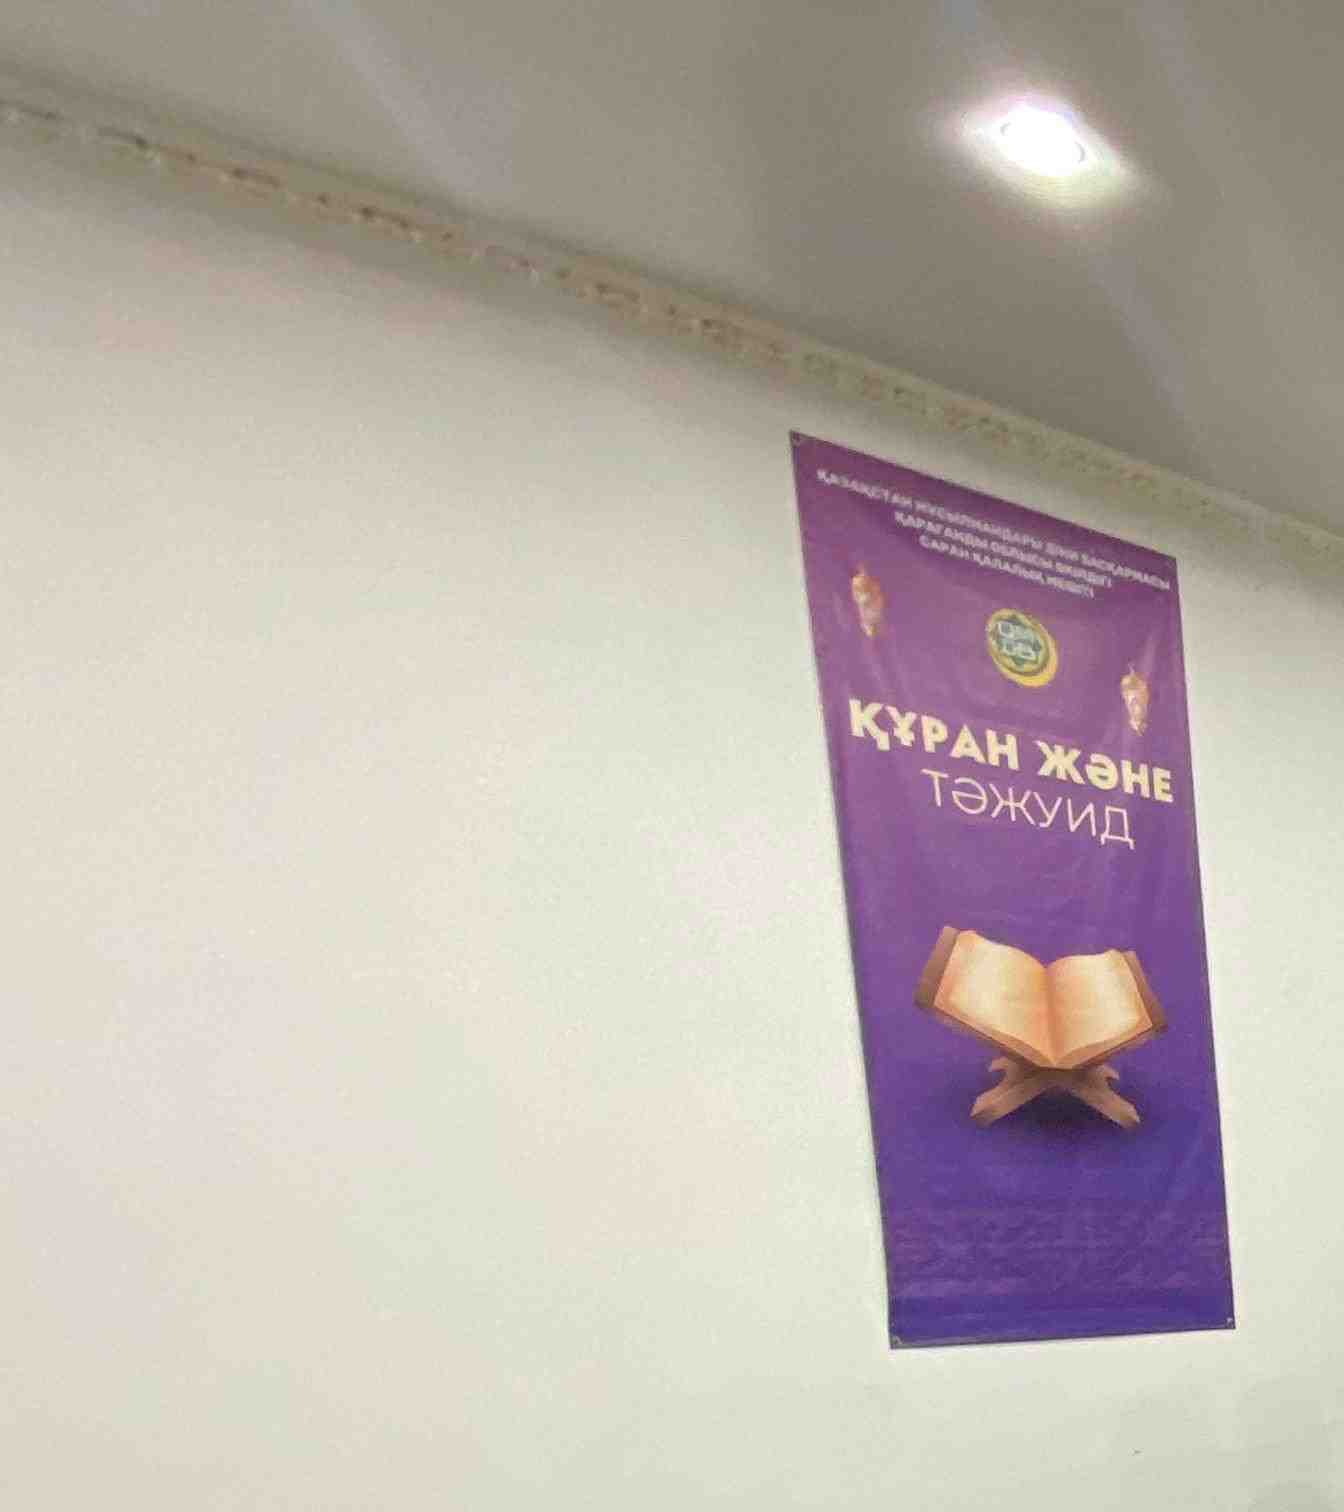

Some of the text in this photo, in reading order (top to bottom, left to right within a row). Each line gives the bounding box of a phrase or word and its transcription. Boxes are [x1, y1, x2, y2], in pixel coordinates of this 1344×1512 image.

[848, 699, 1174, 803] ҚҰРАН ЖӘНЕ
[921, 769, 1135, 850] ТӘЖУИД
